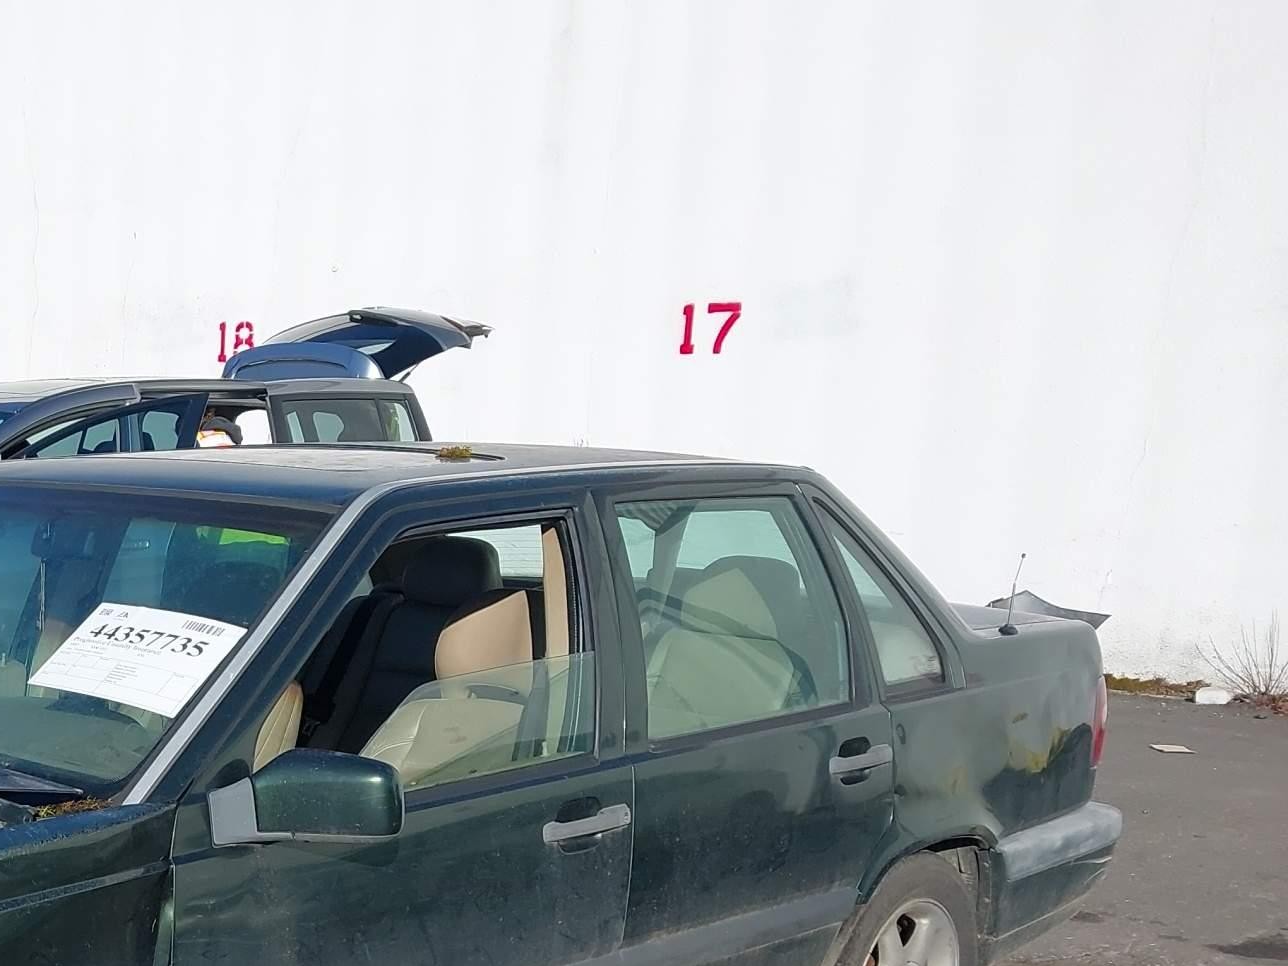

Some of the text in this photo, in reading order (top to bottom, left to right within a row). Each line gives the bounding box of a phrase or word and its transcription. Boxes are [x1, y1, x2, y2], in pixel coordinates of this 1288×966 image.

[217, 321, 254, 363] 18
[680, 303, 741, 355] 17
[89, 623, 210, 657] 44357735
